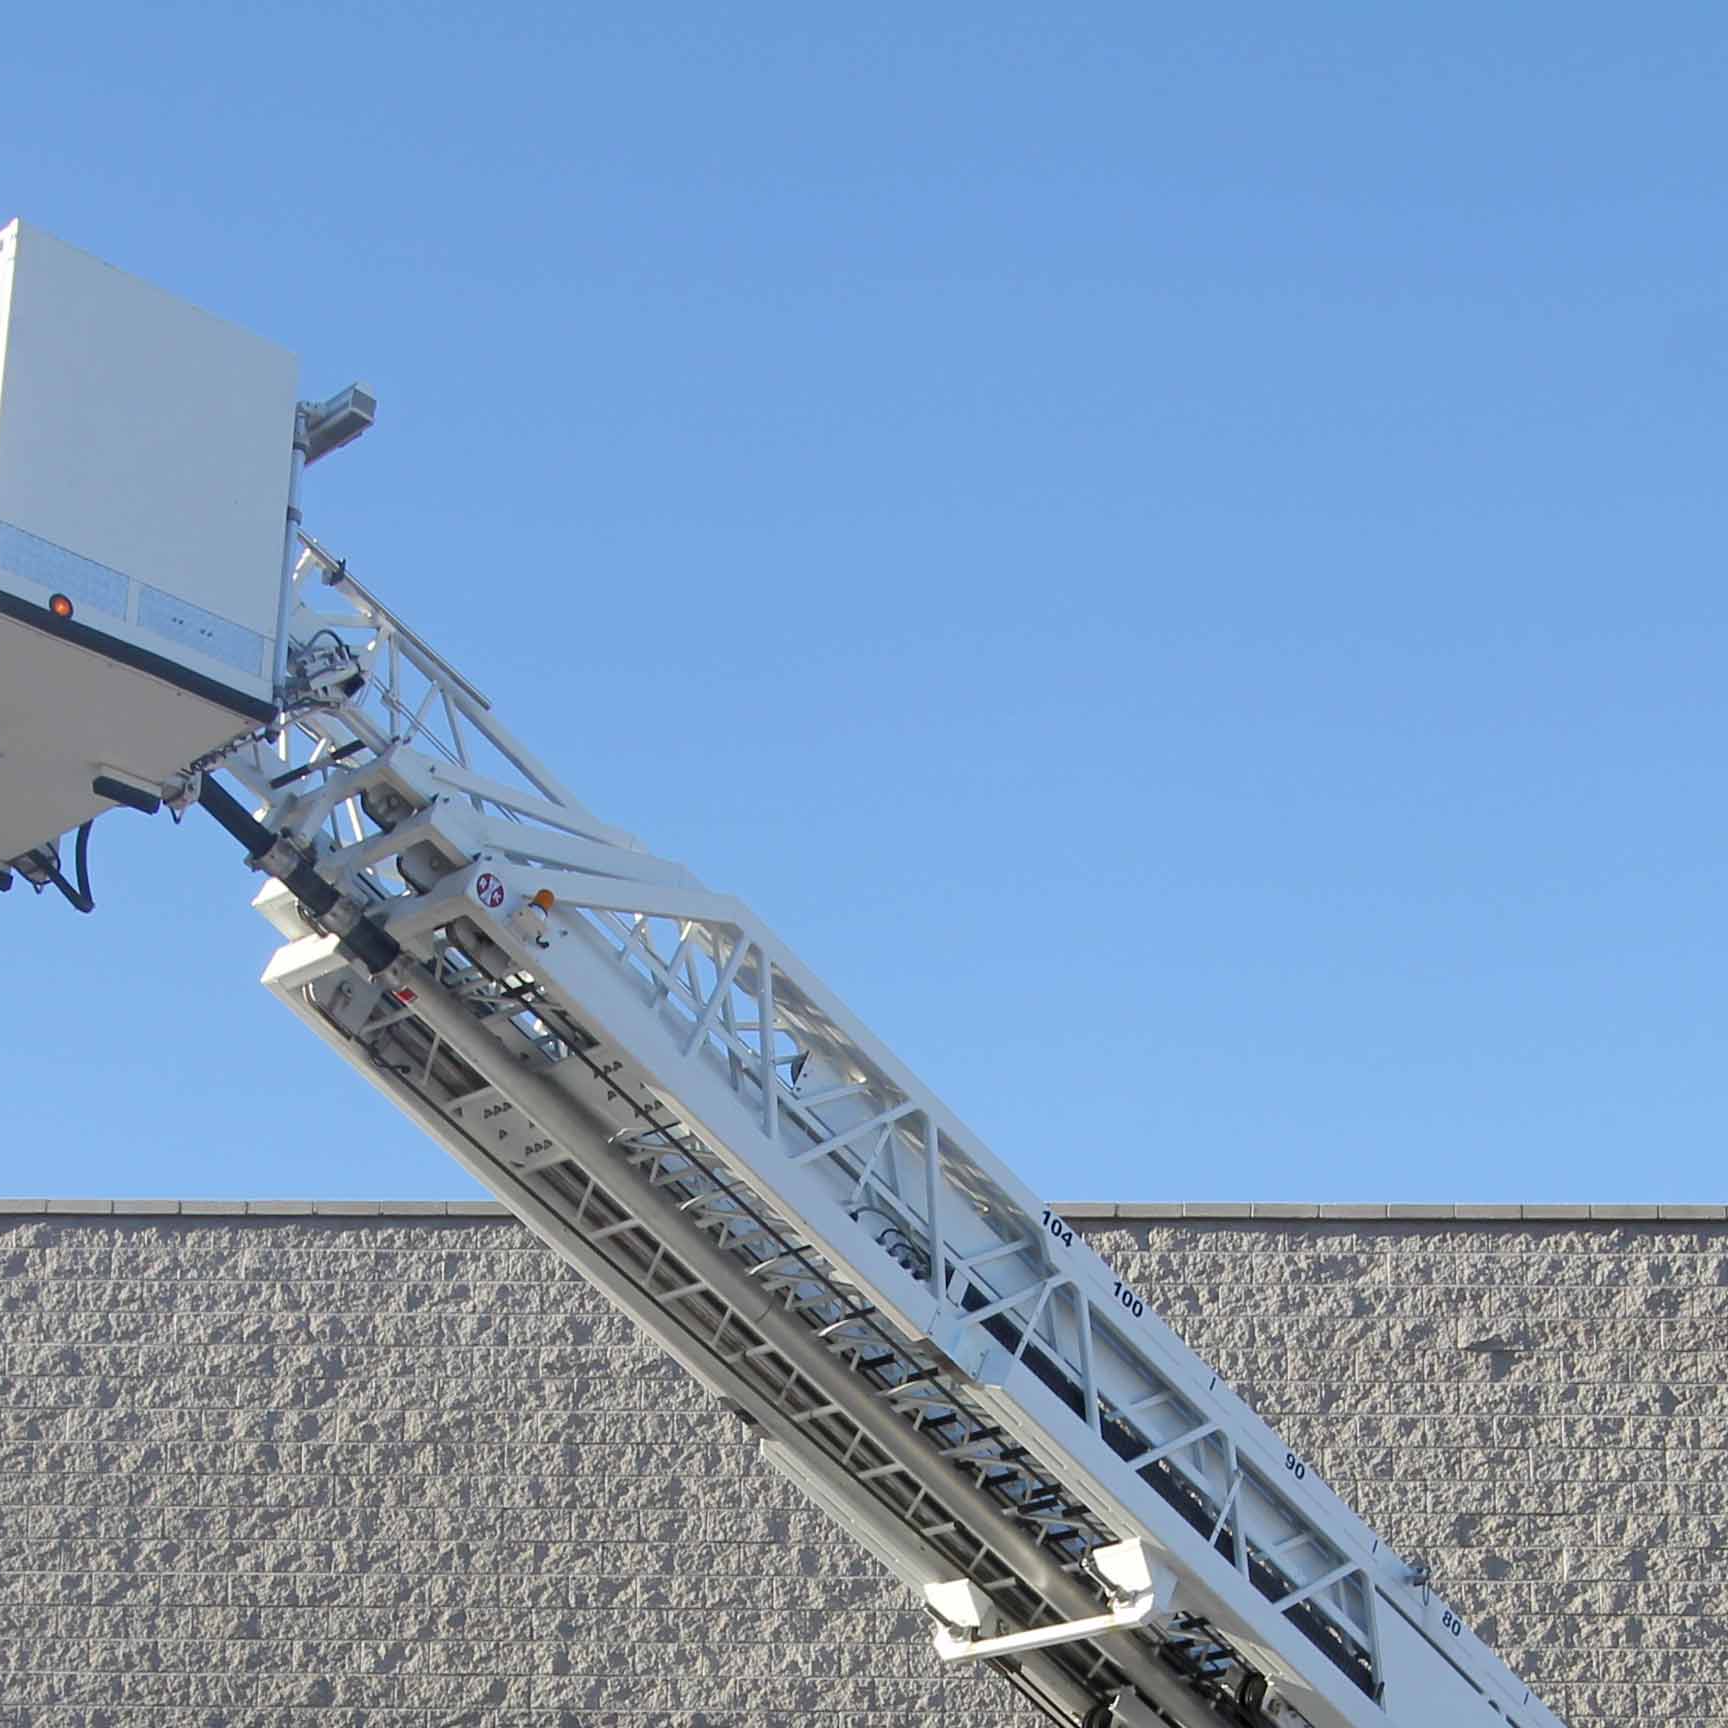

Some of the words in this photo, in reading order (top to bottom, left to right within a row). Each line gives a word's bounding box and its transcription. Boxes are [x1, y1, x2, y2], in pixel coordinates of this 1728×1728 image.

[1042, 1210, 1073, 1248] 104
[1113, 1282, 1144, 1318] 100
[1285, 1453, 1305, 1480] 90
[1442, 1610, 1461, 1637] 80
